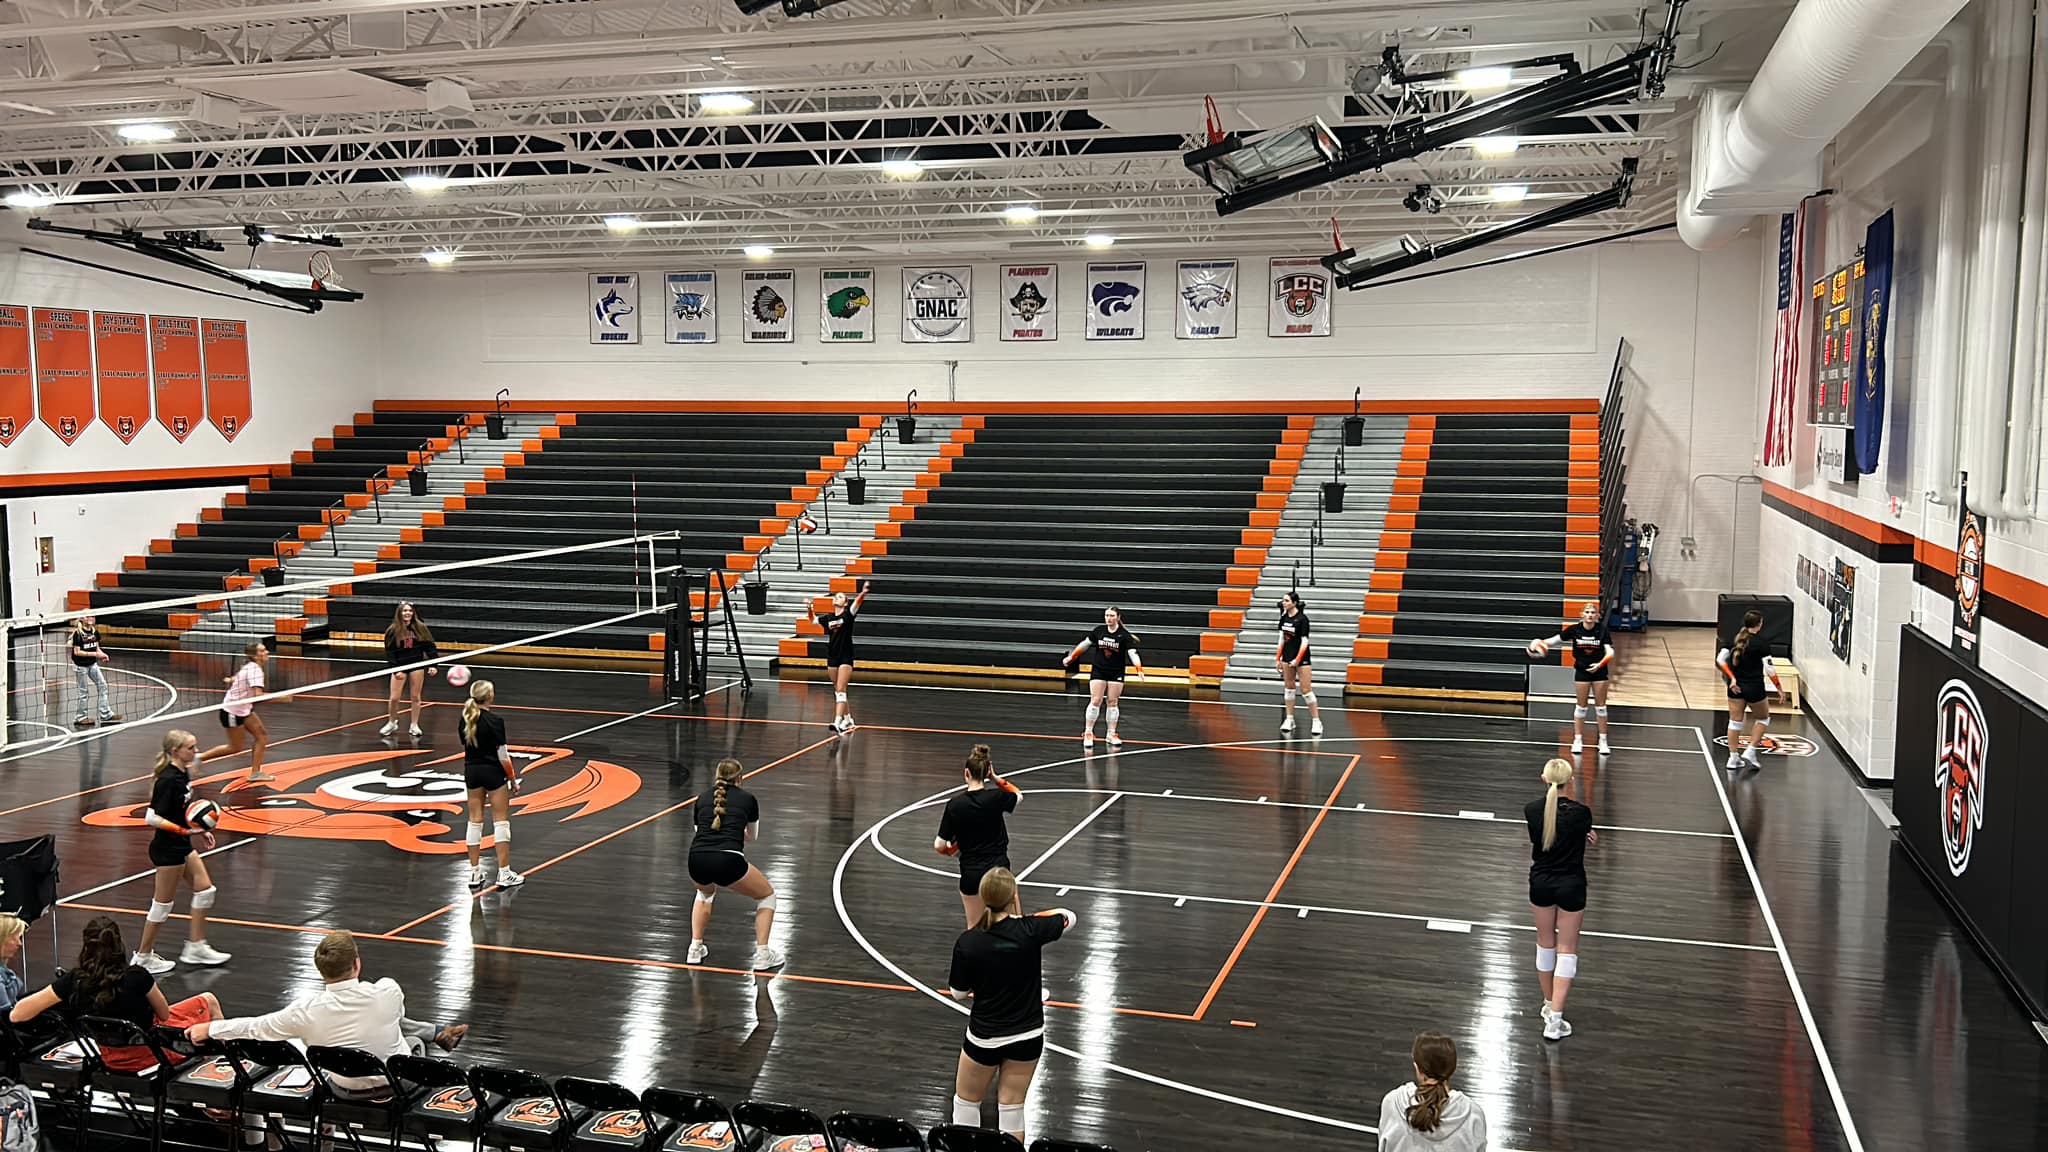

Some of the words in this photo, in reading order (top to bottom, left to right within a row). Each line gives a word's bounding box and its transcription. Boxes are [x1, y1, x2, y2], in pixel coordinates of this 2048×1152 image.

[1008, 267, 1050, 277] PLAINVIEW
[1279, 276, 1323, 294] LCC
[916, 299, 958, 318] GNAC
[50, 312, 73, 322] SPEECH
[1096, 328, 1134, 336] WILDCATS
[1941, 702, 1981, 793] LCC
